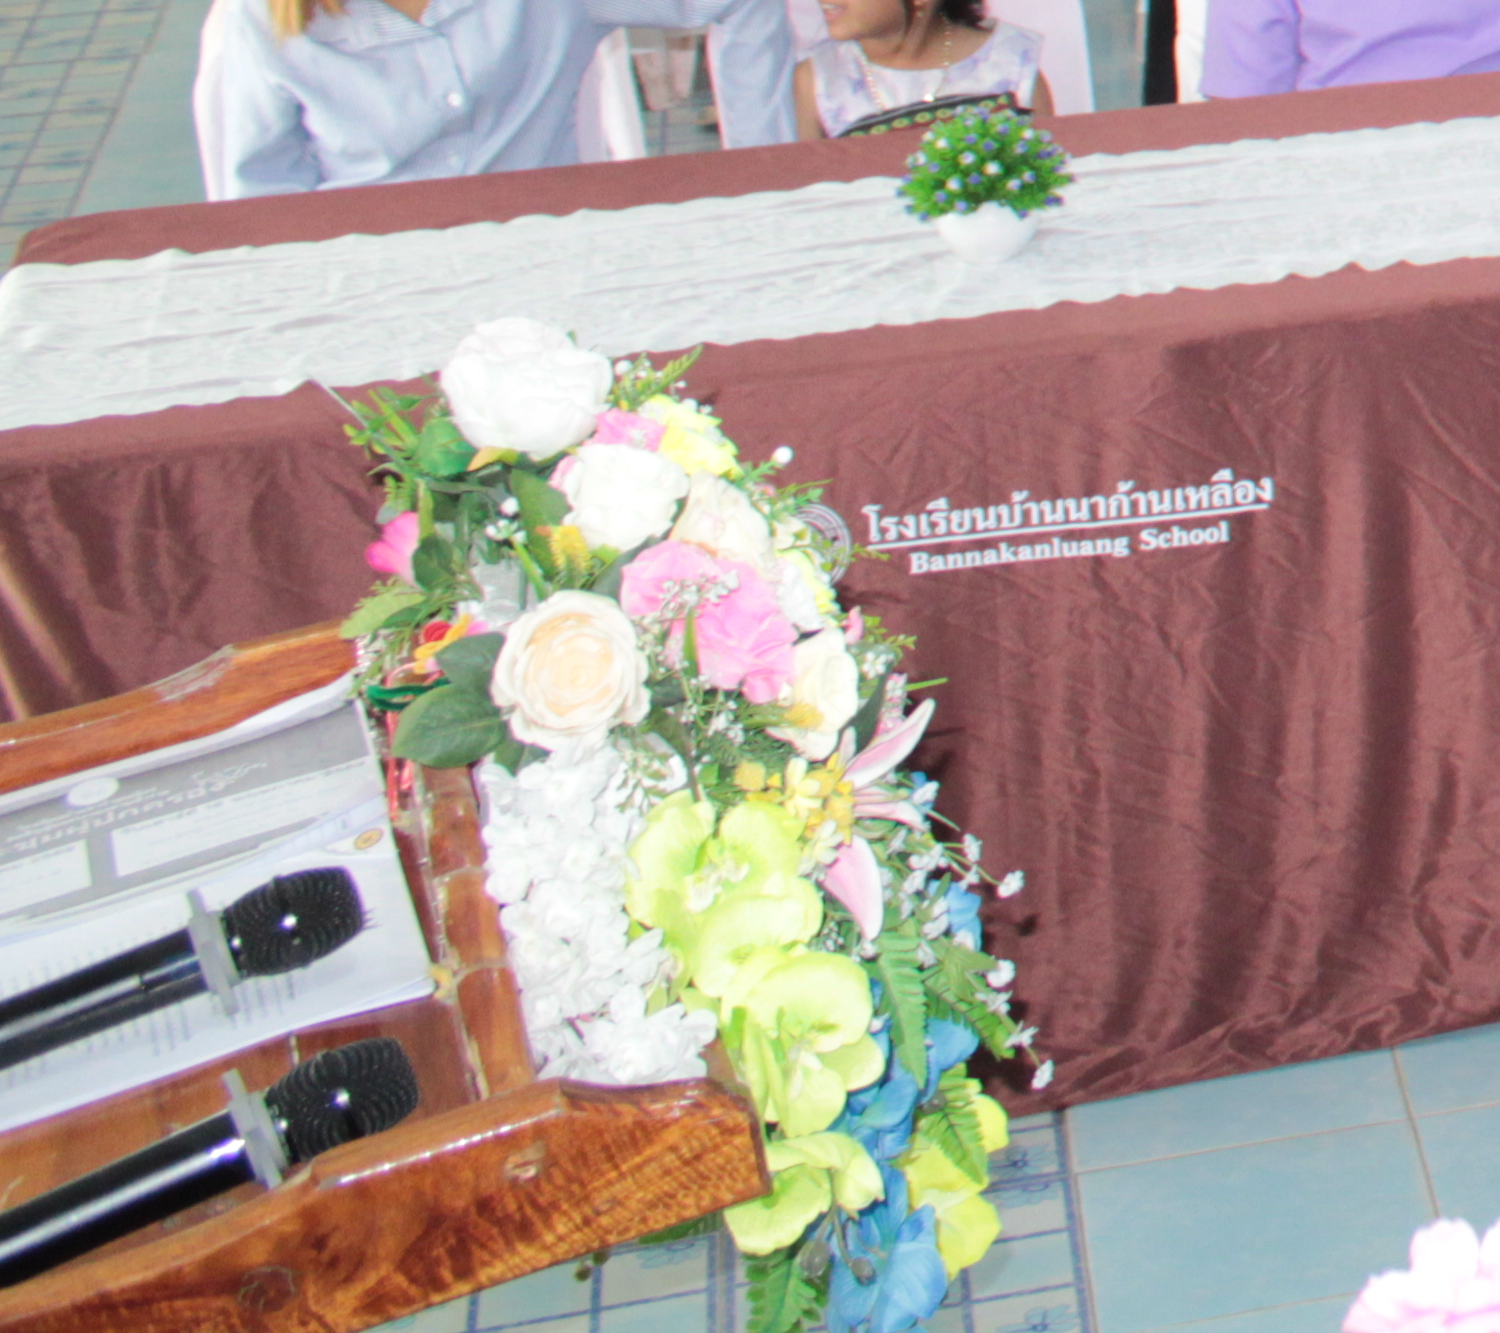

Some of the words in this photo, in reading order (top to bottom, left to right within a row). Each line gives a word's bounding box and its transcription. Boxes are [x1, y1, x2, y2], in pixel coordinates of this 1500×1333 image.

[862, 468, 1274, 541] โรงเรียนบ้านนาก้านเหลือง
[910, 536, 1130, 574] Bannakanluang
[1139, 521, 1231, 552] School
